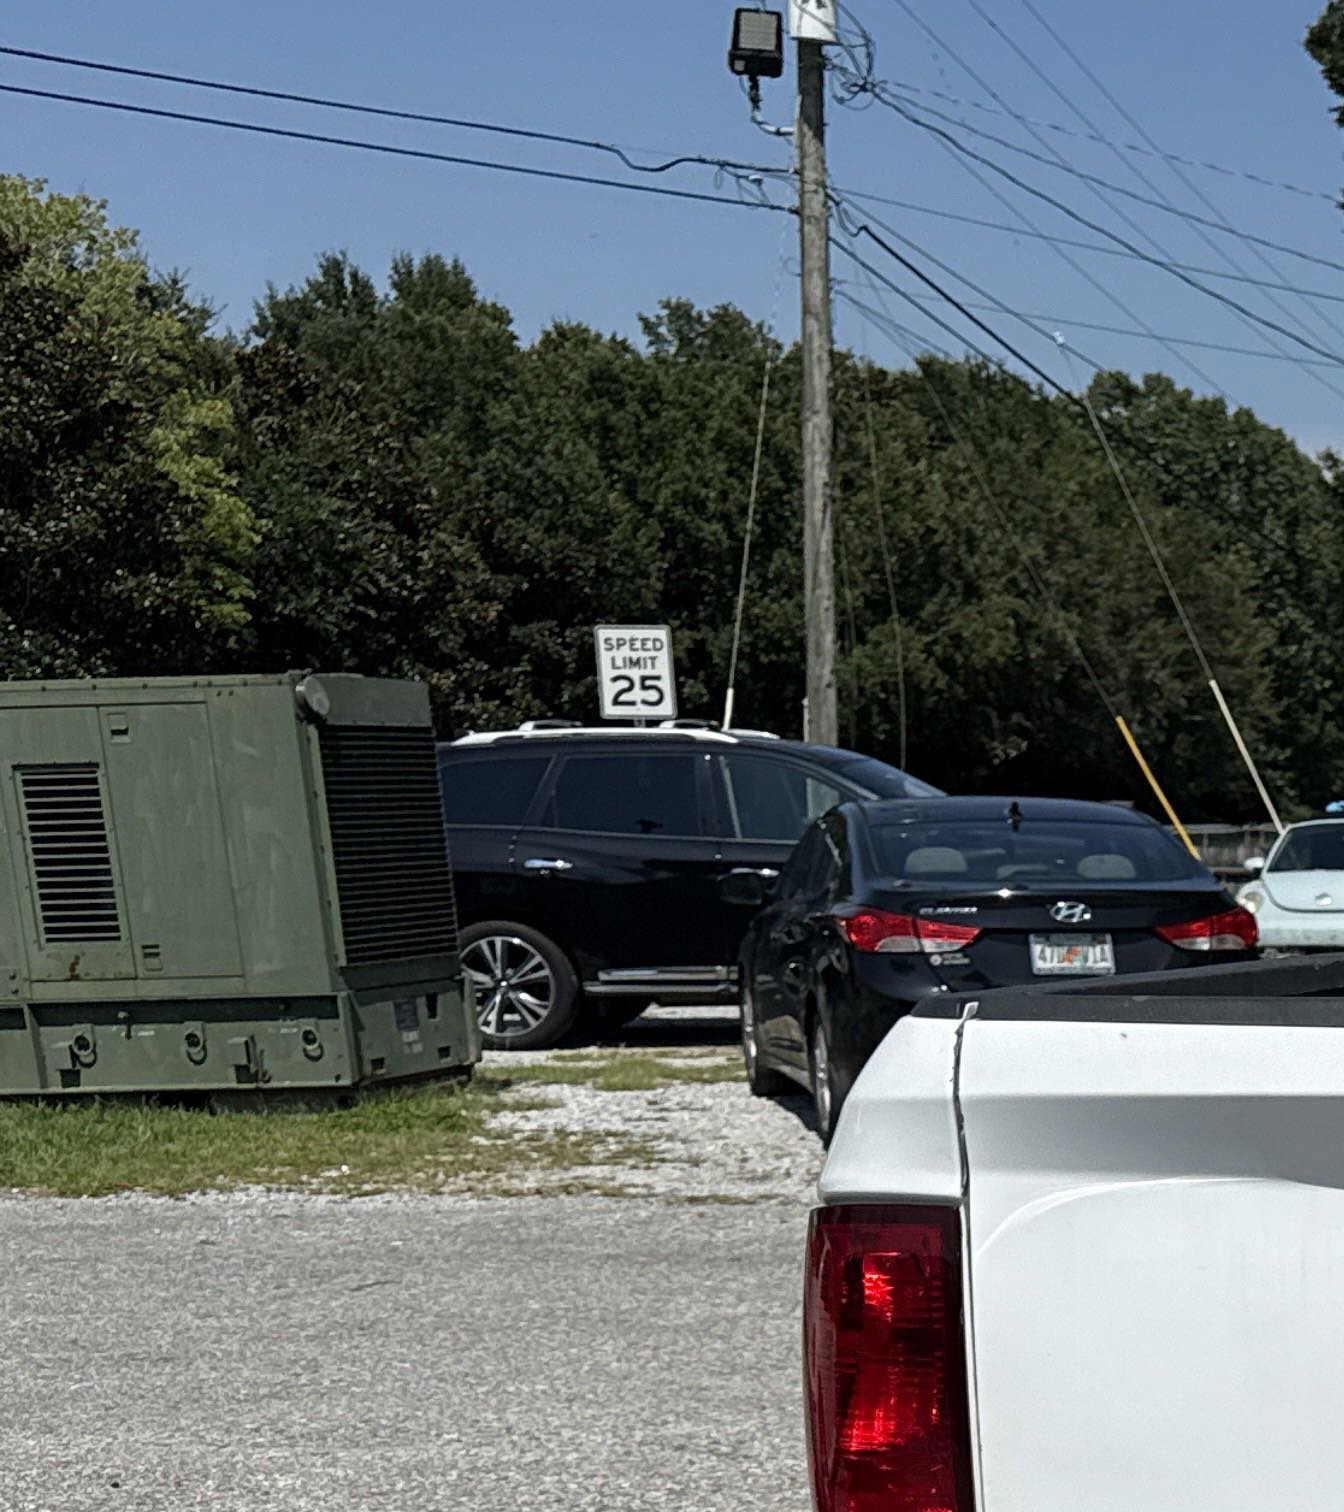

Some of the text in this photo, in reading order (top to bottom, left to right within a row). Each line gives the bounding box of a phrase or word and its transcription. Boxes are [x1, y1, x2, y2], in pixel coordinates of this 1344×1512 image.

[603, 637, 664, 651] SPEED
[611, 655, 658, 670] LIMIT
[609, 674, 664, 706] 25
